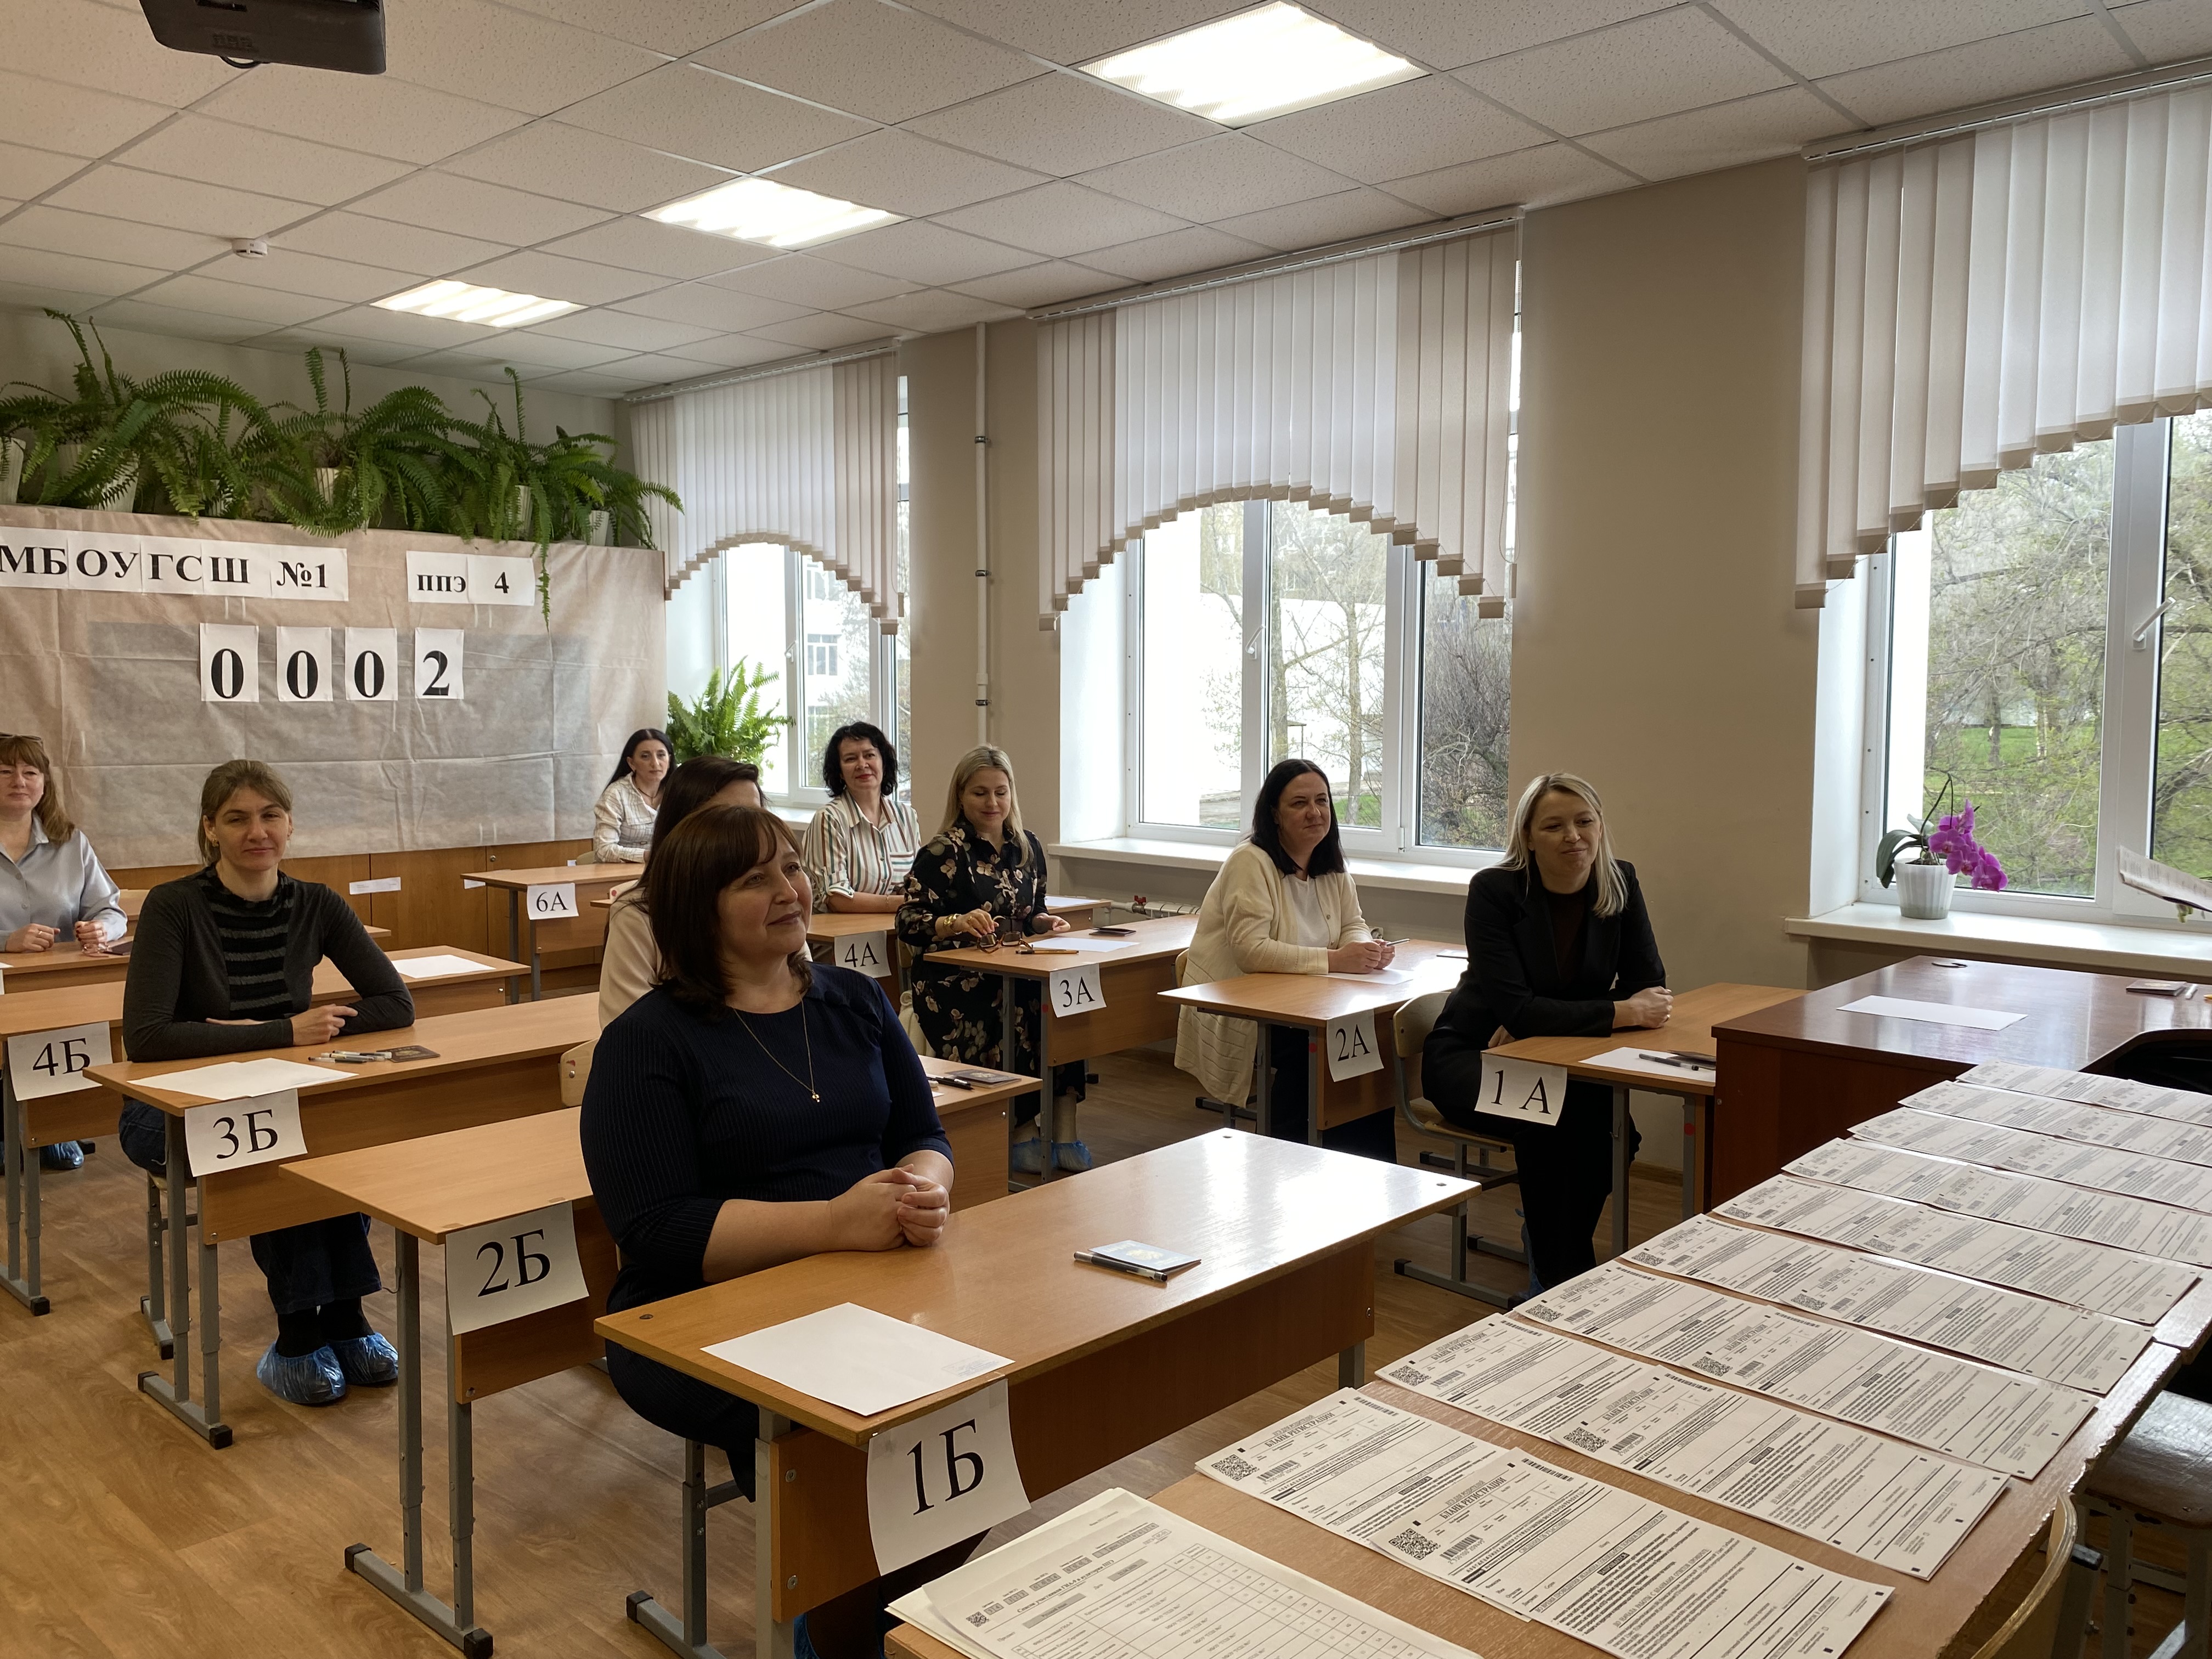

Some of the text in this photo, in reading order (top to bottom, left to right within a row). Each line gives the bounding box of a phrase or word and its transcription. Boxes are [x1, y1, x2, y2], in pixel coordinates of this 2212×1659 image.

[276, 561, 329, 588] №1
[494, 571, 509, 594] 4
[535, 891, 569, 913] 6А
[844, 941, 880, 968] 4А
[1059, 976, 1096, 1008] 3А
[32, 1037, 91, 1076] 4Б
[1335, 1024, 1370, 1062] 2А
[213, 1108, 279, 1160] 3Б
[476, 1228, 550, 1297] 2Б
[1264, 1433, 1290, 1447] БЛАНК
[1289, 1412, 1335, 1437] РЕГИСТРАЦИИ
[907, 1418, 984, 1516] 1Б
[1439, 1477, 1507, 1519] БЛАНК РЕГИСТРАЦИИ
